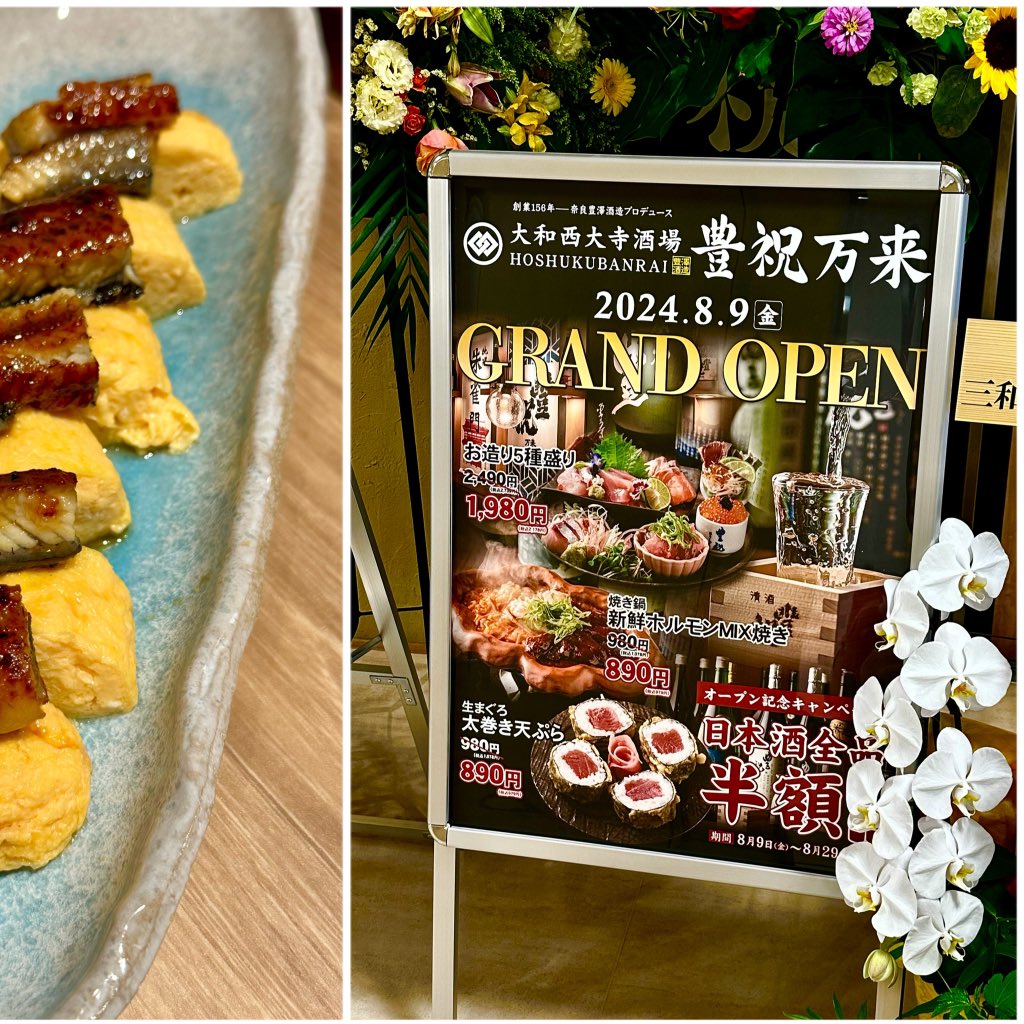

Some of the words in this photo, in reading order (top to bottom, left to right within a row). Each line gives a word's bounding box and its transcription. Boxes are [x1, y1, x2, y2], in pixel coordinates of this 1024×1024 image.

[509, 252, 668, 274] HOSHUKUBANRAI
[510, 222, 683, 254] 大和西大寺酒場
[691, 213, 932, 290] 豊祝万来
[593, 290, 749, 328] 2024.8.9
[456, 322, 701, 396] GRAND
[723, 338, 928, 411] OPEN
[463, 443, 576, 469] お造り5種盛り
[463, 469, 519, 489] 2,490円
[465, 495, 548, 527] 1,980円
[608, 594, 647, 611] 焼き鍋
[607, 609, 790, 646] 新鮮ホルモンMIX焼き
[607, 633, 649, 653] 980円
[605, 658, 671, 689] 890円
[461, 700, 508, 717] 生まぐろ
[704, 686, 853, 716] オープン記念キャンペ
[461, 715, 566, 743] 太巻き天ぷら
[460, 736, 500, 755] 980円
[460, 759, 522, 790] 890円
[709, 831, 734, 844] 期間
